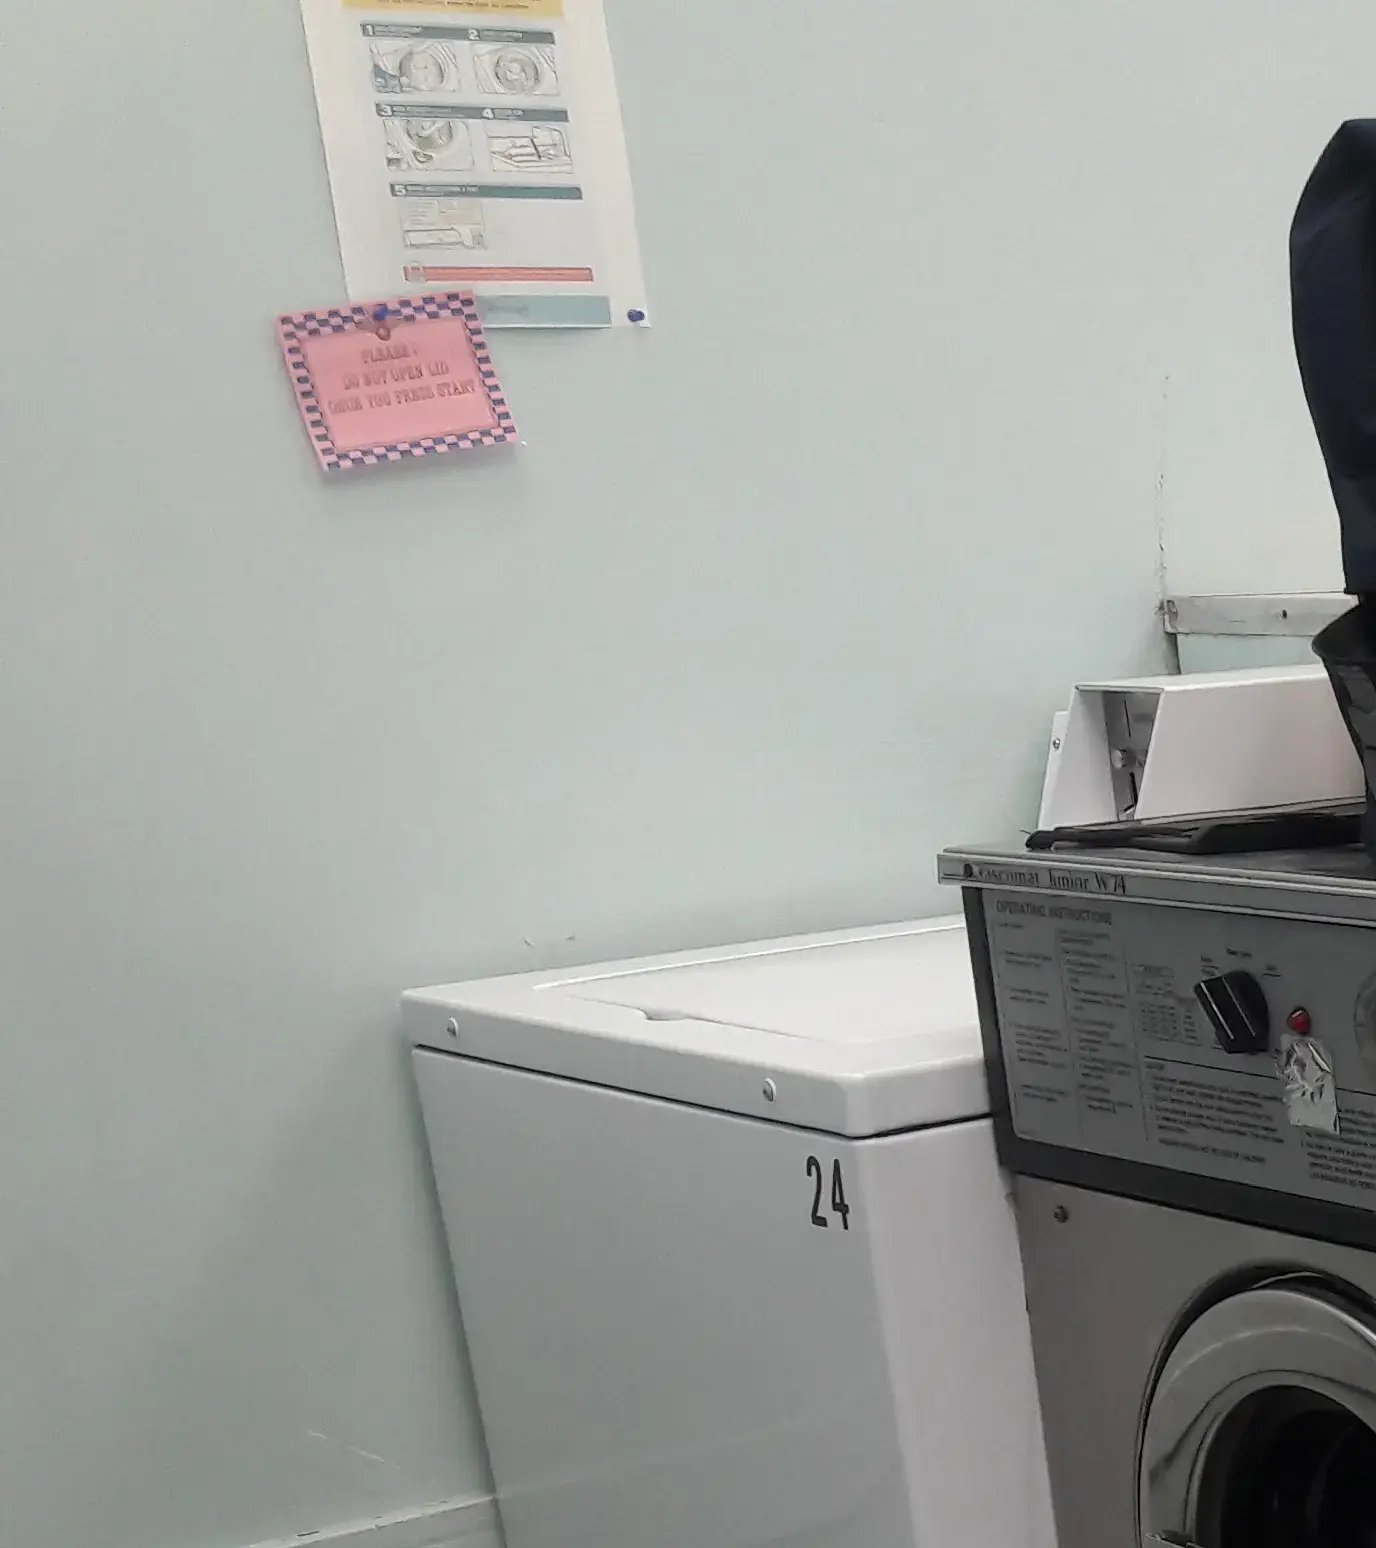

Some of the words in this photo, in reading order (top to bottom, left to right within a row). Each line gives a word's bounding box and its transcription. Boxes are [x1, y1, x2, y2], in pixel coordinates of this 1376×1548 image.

[391, 365, 423, 382] OPEN
[1048, 868, 1090, 890] Junior
[805, 1156, 850, 1230] 24
